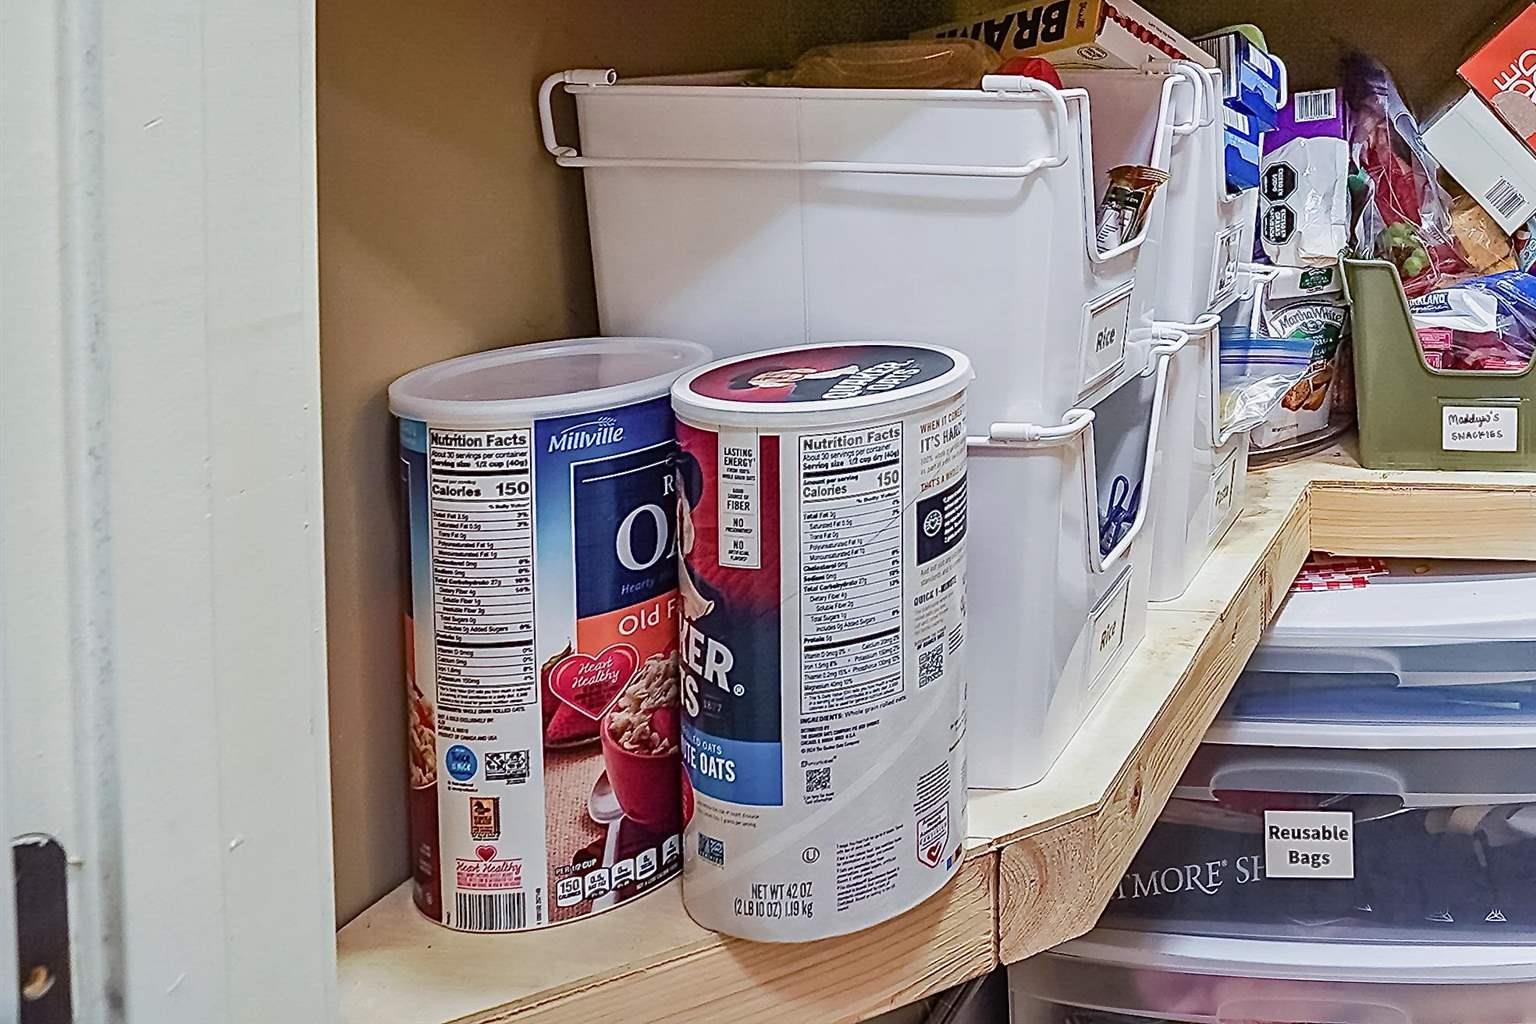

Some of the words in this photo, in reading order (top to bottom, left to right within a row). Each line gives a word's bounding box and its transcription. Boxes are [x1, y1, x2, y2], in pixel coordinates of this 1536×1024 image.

[1278, 309, 1312, 333] Martha
[1311, 305, 1343, 323] White
[1096, 326, 1115, 352] Rice
[431, 433, 482, 447] Nutrition
[486, 433, 527, 447] Facts
[548, 427, 624, 453] Millville
[804, 435, 862, 451] Nutrition
[867, 428, 900, 443] Facts
[920, 432, 940, 453] IT'S
[1451, 430, 1503, 441] SNACKIES
[724, 447, 752, 457] LASTING
[804, 454, 820, 462] About
[866, 444, 891, 453] container
[431, 459, 454, 468] Serving
[475, 460, 488, 468] 1/2
[803, 462, 829, 470] Serving
[432, 485, 481, 497] Calories
[495, 481, 529, 497] 150
[803, 485, 847, 497] Calories
[877, 470, 899, 487] 150
[727, 500, 750, 511] FIBER
[733, 518, 744, 528] NO
[733, 540, 744, 550] NO
[618, 605, 660, 636] Old
[1100, 621, 1116, 651] Rice
[578, 656, 614, 675] Heart
[572, 669, 619, 688] Healthy
[702, 741, 722, 755] OATS
[700, 752, 736, 782] OATS
[1269, 825, 1349, 841] Reusable
[482, 861, 522, 875] Healthy
[582, 858, 597, 868] CUP
[1288, 850, 1330, 868] Bags
[560, 879, 580, 894] 150
[751, 883, 769, 899] NET
[770, 883, 785, 899] WT
[786, 882, 799, 898] 42
[800, 881, 813, 897] OZ
[734, 899, 743, 917] (2
[744, 901, 755, 915] LB
[766, 899, 782, 918] OZ)
[784, 900, 800, 916] 1.19
[801, 900, 814, 918] kg
